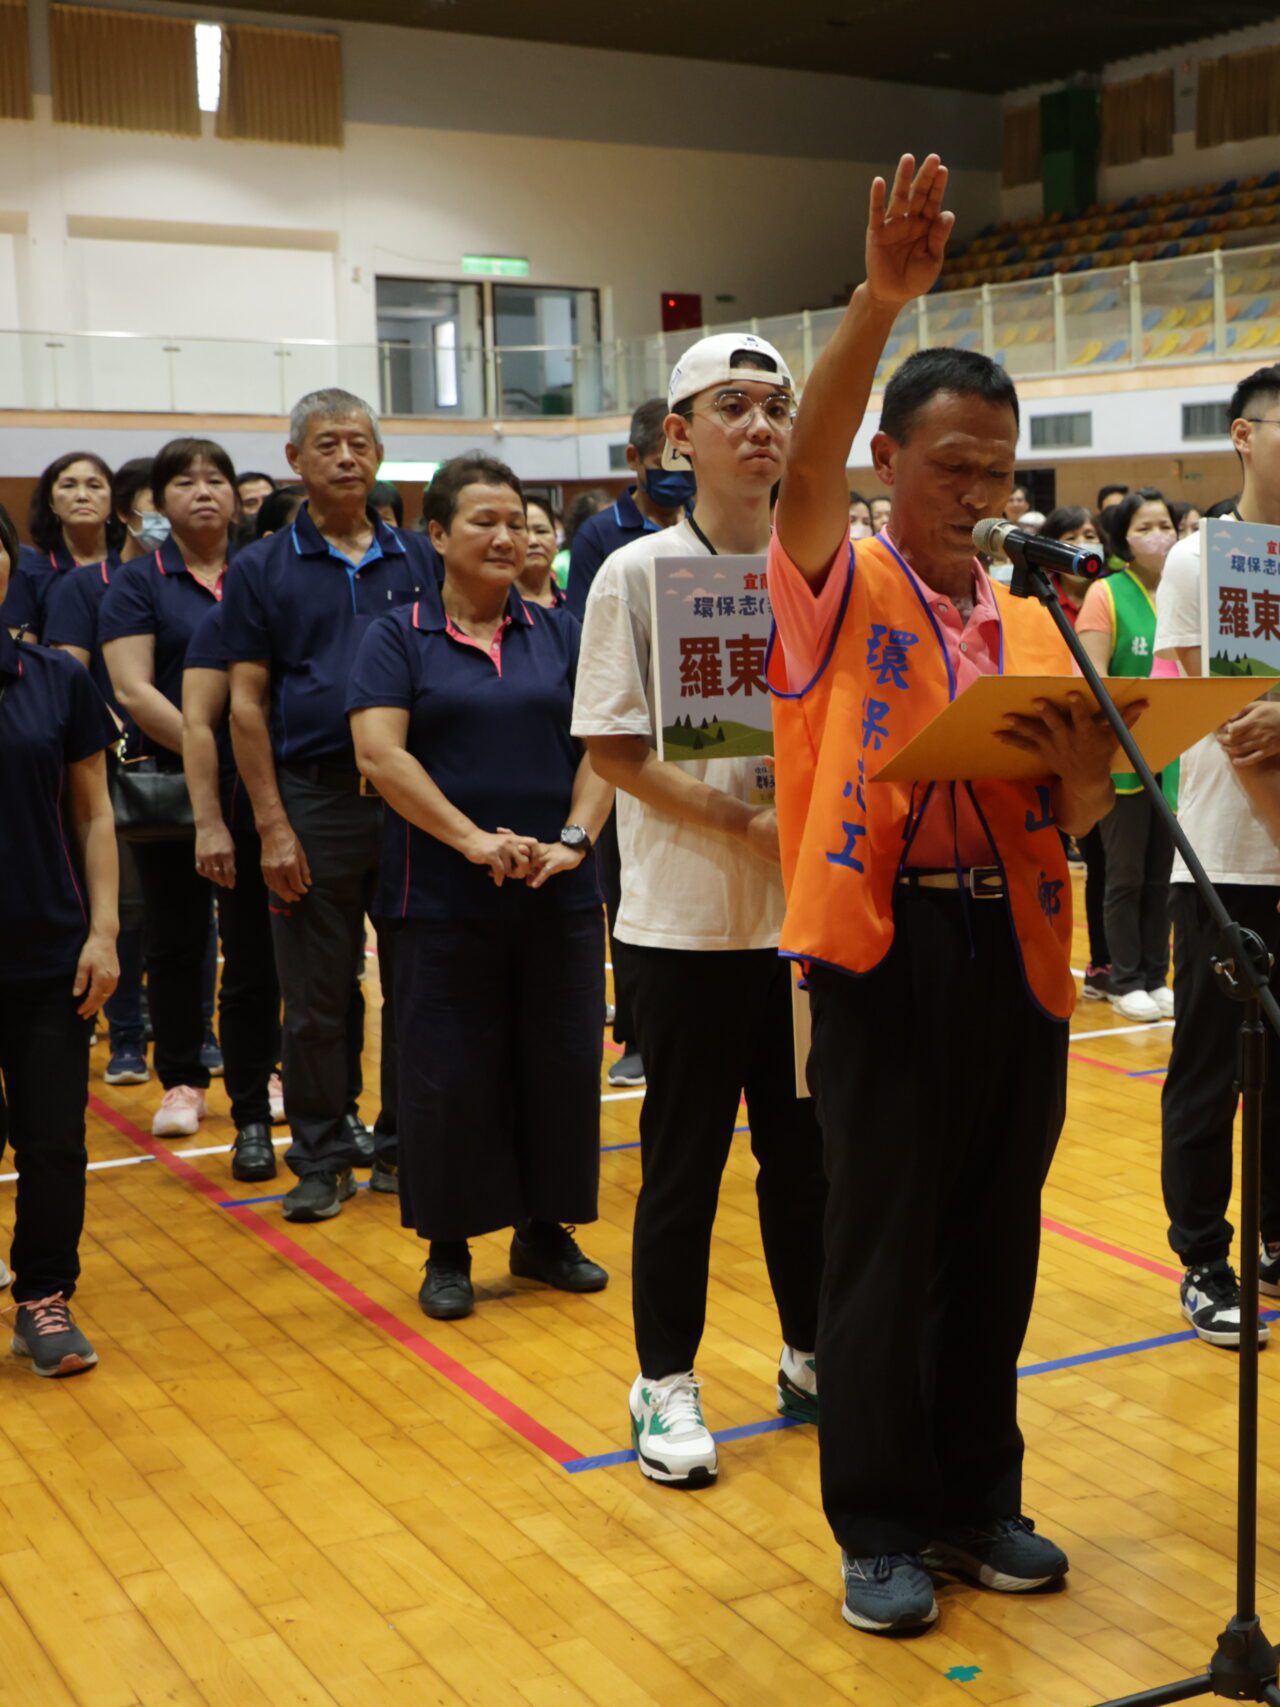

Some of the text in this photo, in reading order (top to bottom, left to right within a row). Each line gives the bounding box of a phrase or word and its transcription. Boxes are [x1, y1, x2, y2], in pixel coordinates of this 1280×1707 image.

[693, 595, 773, 618] 環保志(
[679, 634, 769, 698] 羅東
